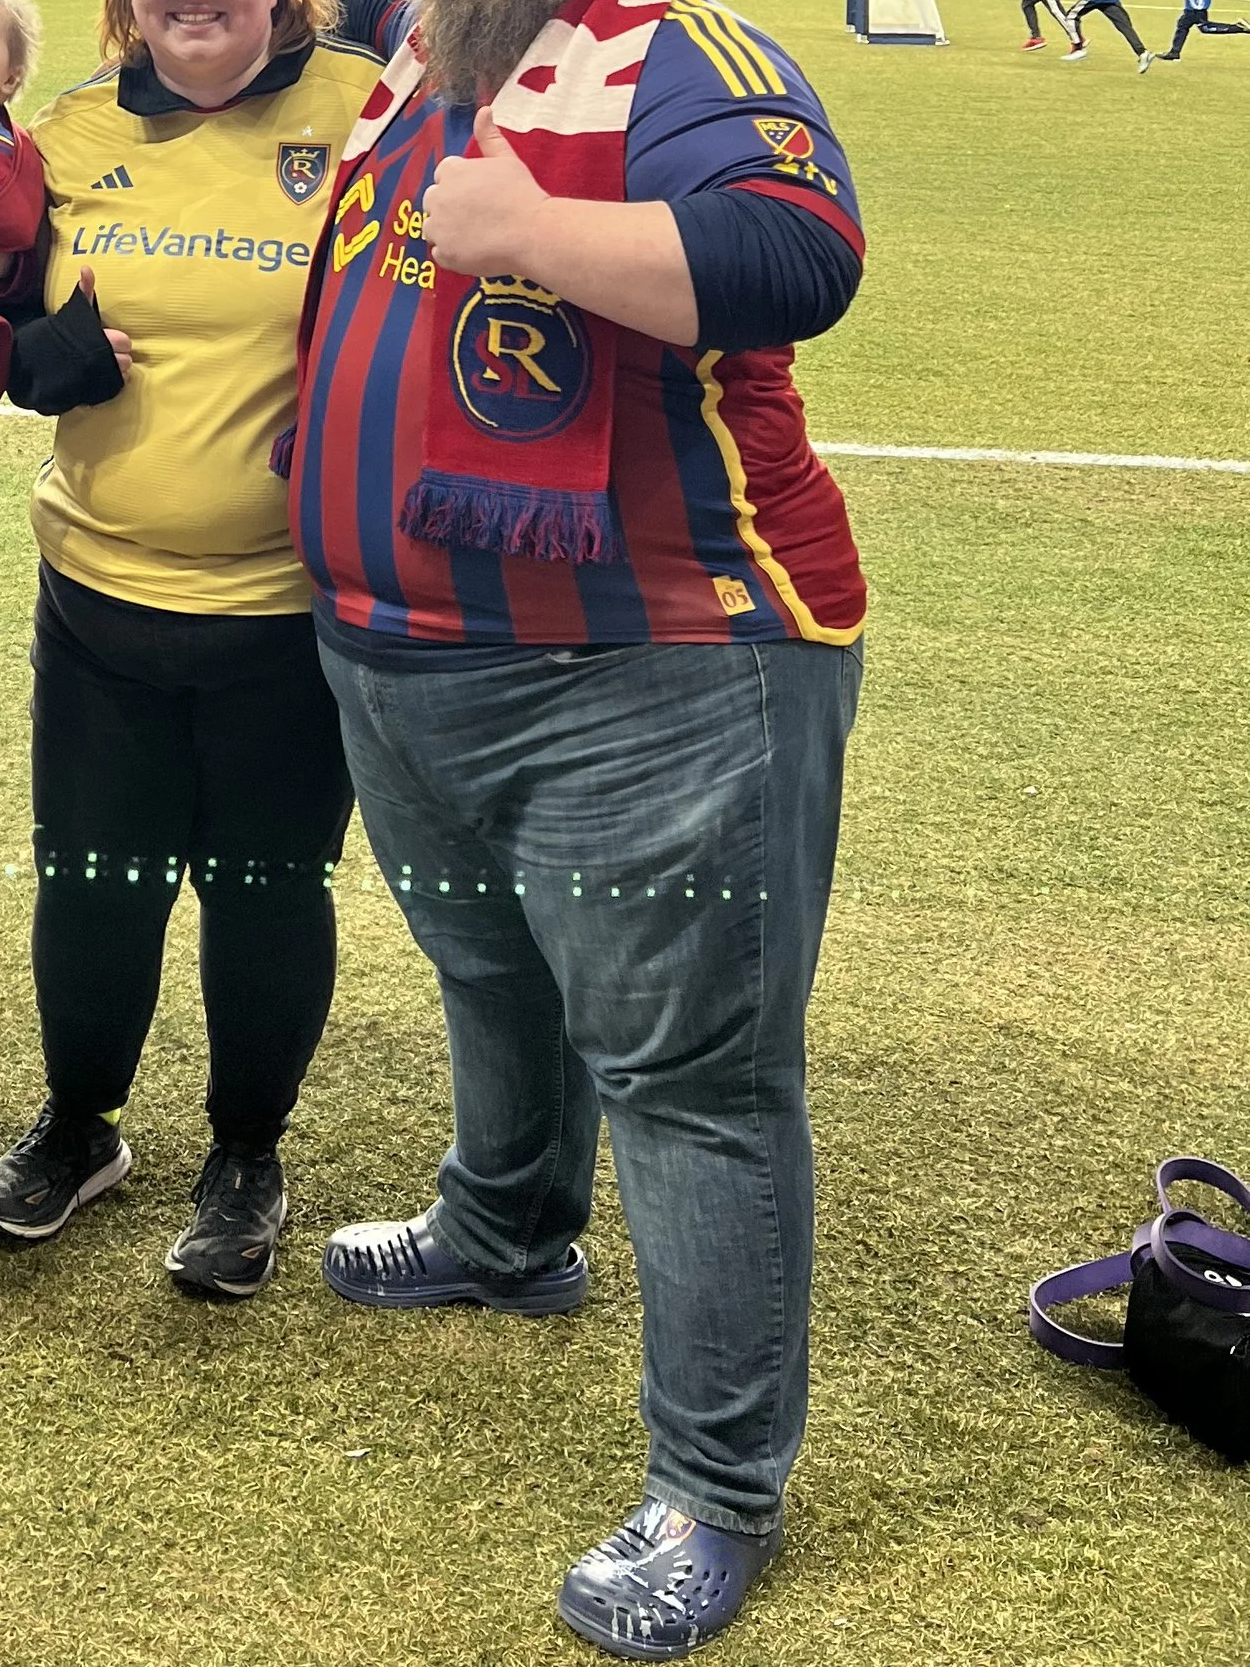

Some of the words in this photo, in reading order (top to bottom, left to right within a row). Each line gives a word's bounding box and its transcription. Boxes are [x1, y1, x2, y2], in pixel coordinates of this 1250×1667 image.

[393, 199, 430, 240] Se
[72, 221, 311, 272] LifeVantage
[721, 588, 749, 608] 05
